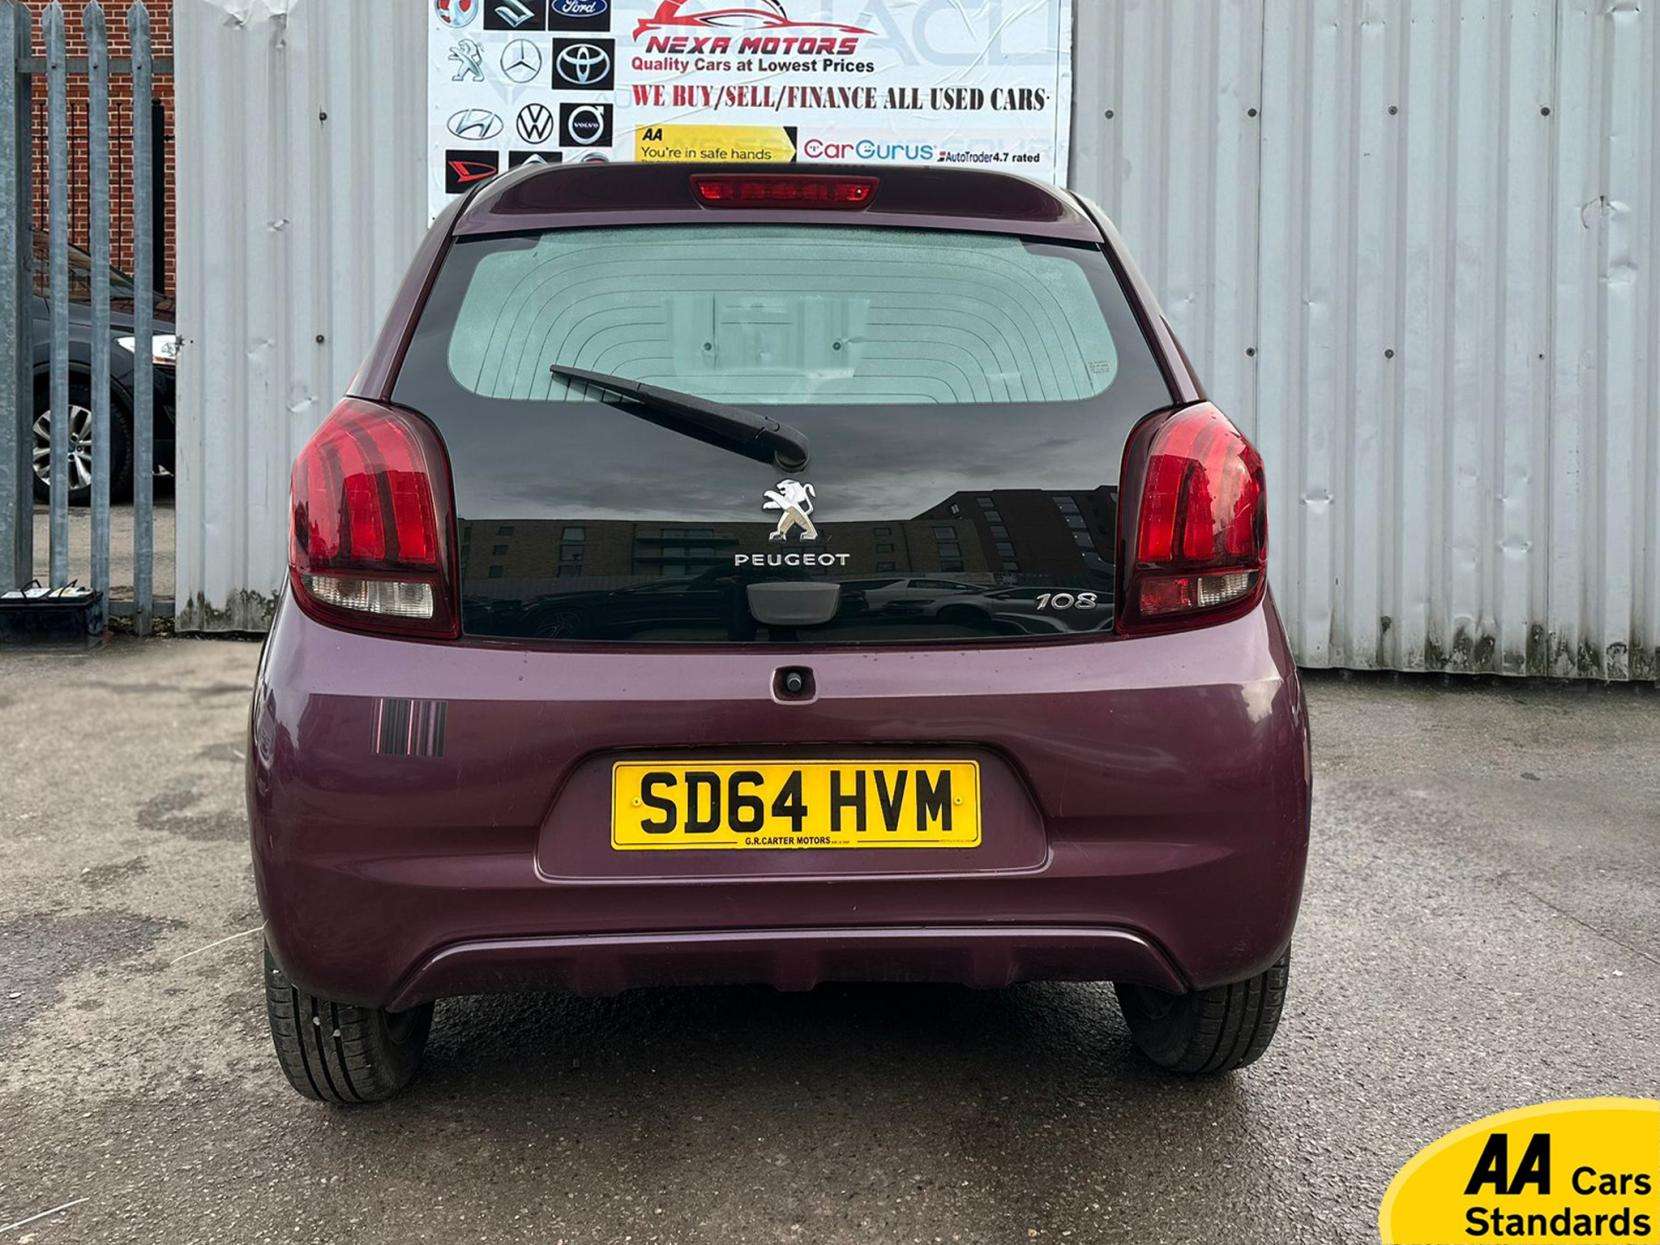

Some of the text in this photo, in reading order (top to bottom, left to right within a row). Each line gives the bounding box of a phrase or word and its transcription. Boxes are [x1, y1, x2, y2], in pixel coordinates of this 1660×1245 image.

[645, 36, 859, 55] NEXA MOTORS
[631, 57, 874, 73] Quality Cars at Lowest Prices
[631, 84, 665, 107] WE
[884, 87, 923, 109] ALL
[930, 87, 984, 110] USED
[642, 128, 663, 141] AA
[641, 146, 771, 160] You're in safe hands
[804, 139, 933, 160] CarGurus
[1012, 153, 1040, 163] rated
[734, 553, 851, 567] PEUGEOT
[1036, 592, 1098, 611] 108
[640, 769, 952, 834] SD64 HVM
[797, 836, 831, 845] MOTORS
